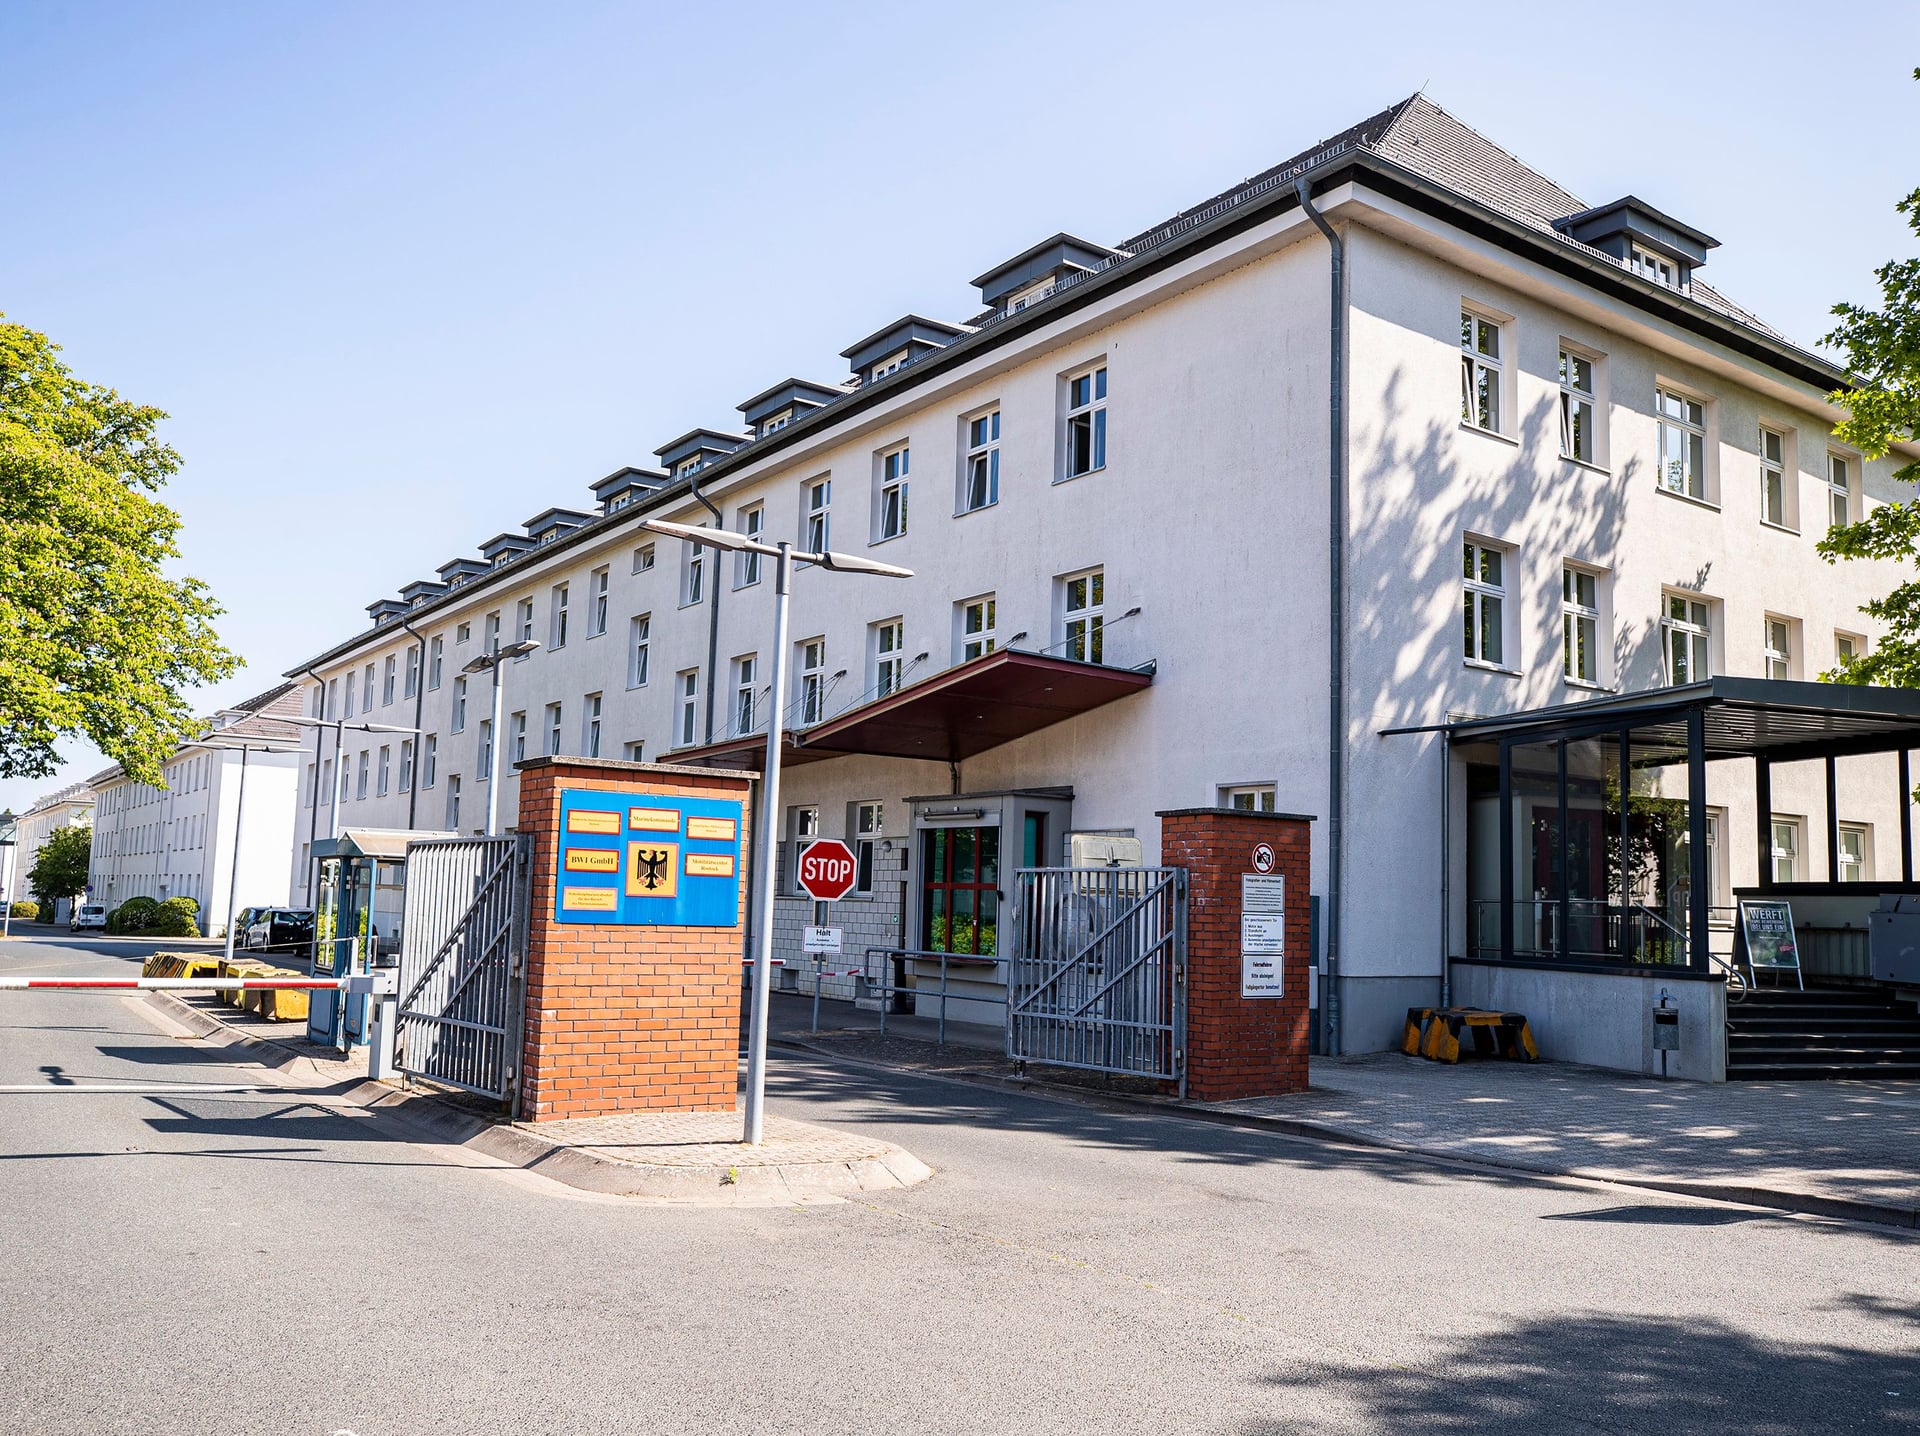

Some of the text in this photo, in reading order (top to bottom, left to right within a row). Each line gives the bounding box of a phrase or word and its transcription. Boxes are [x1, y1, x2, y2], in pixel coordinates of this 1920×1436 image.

[571, 856, 613, 865] BWI GmbH
[804, 856, 851, 883] STOP
[1750, 909, 1782, 920] WERFT
[816, 929, 831, 937] Halt
